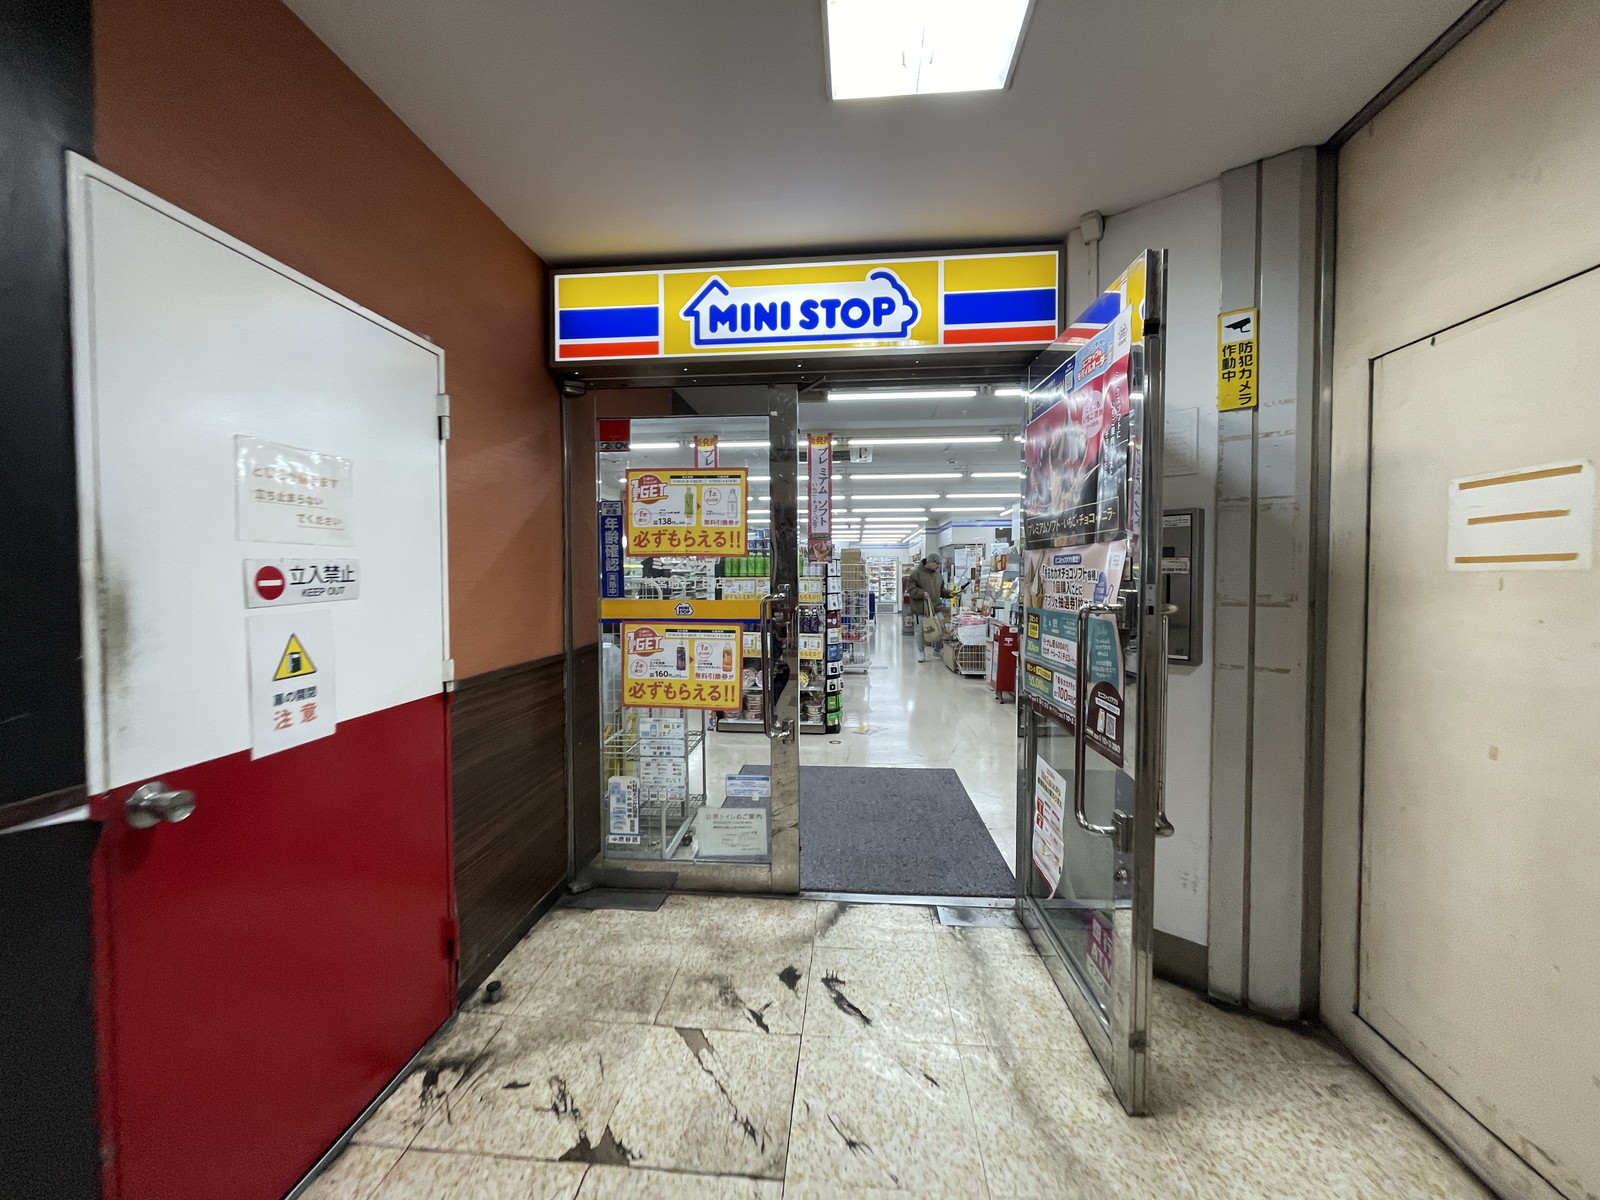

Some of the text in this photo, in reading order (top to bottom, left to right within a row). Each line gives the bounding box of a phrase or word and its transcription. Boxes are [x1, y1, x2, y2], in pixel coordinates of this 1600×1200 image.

[709, 295, 897, 333] MINI STOP
[1222, 344, 1236, 382] 作動中
[1238, 341, 1254, 406] 防犯カメラ
[640, 482, 668, 498] GET
[604, 517, 619, 572] 年齢確認
[633, 529, 741, 548] 必ずもらえる!!
[289, 565, 355, 585] 立入禁止
[301, 586, 345, 598] KEEP OUT
[636, 636, 663, 650] GET
[272, 686, 318, 707] 扉の開閉
[628, 681, 735, 702] 必ずもらえる!!
[272, 702, 318, 731] 注意
